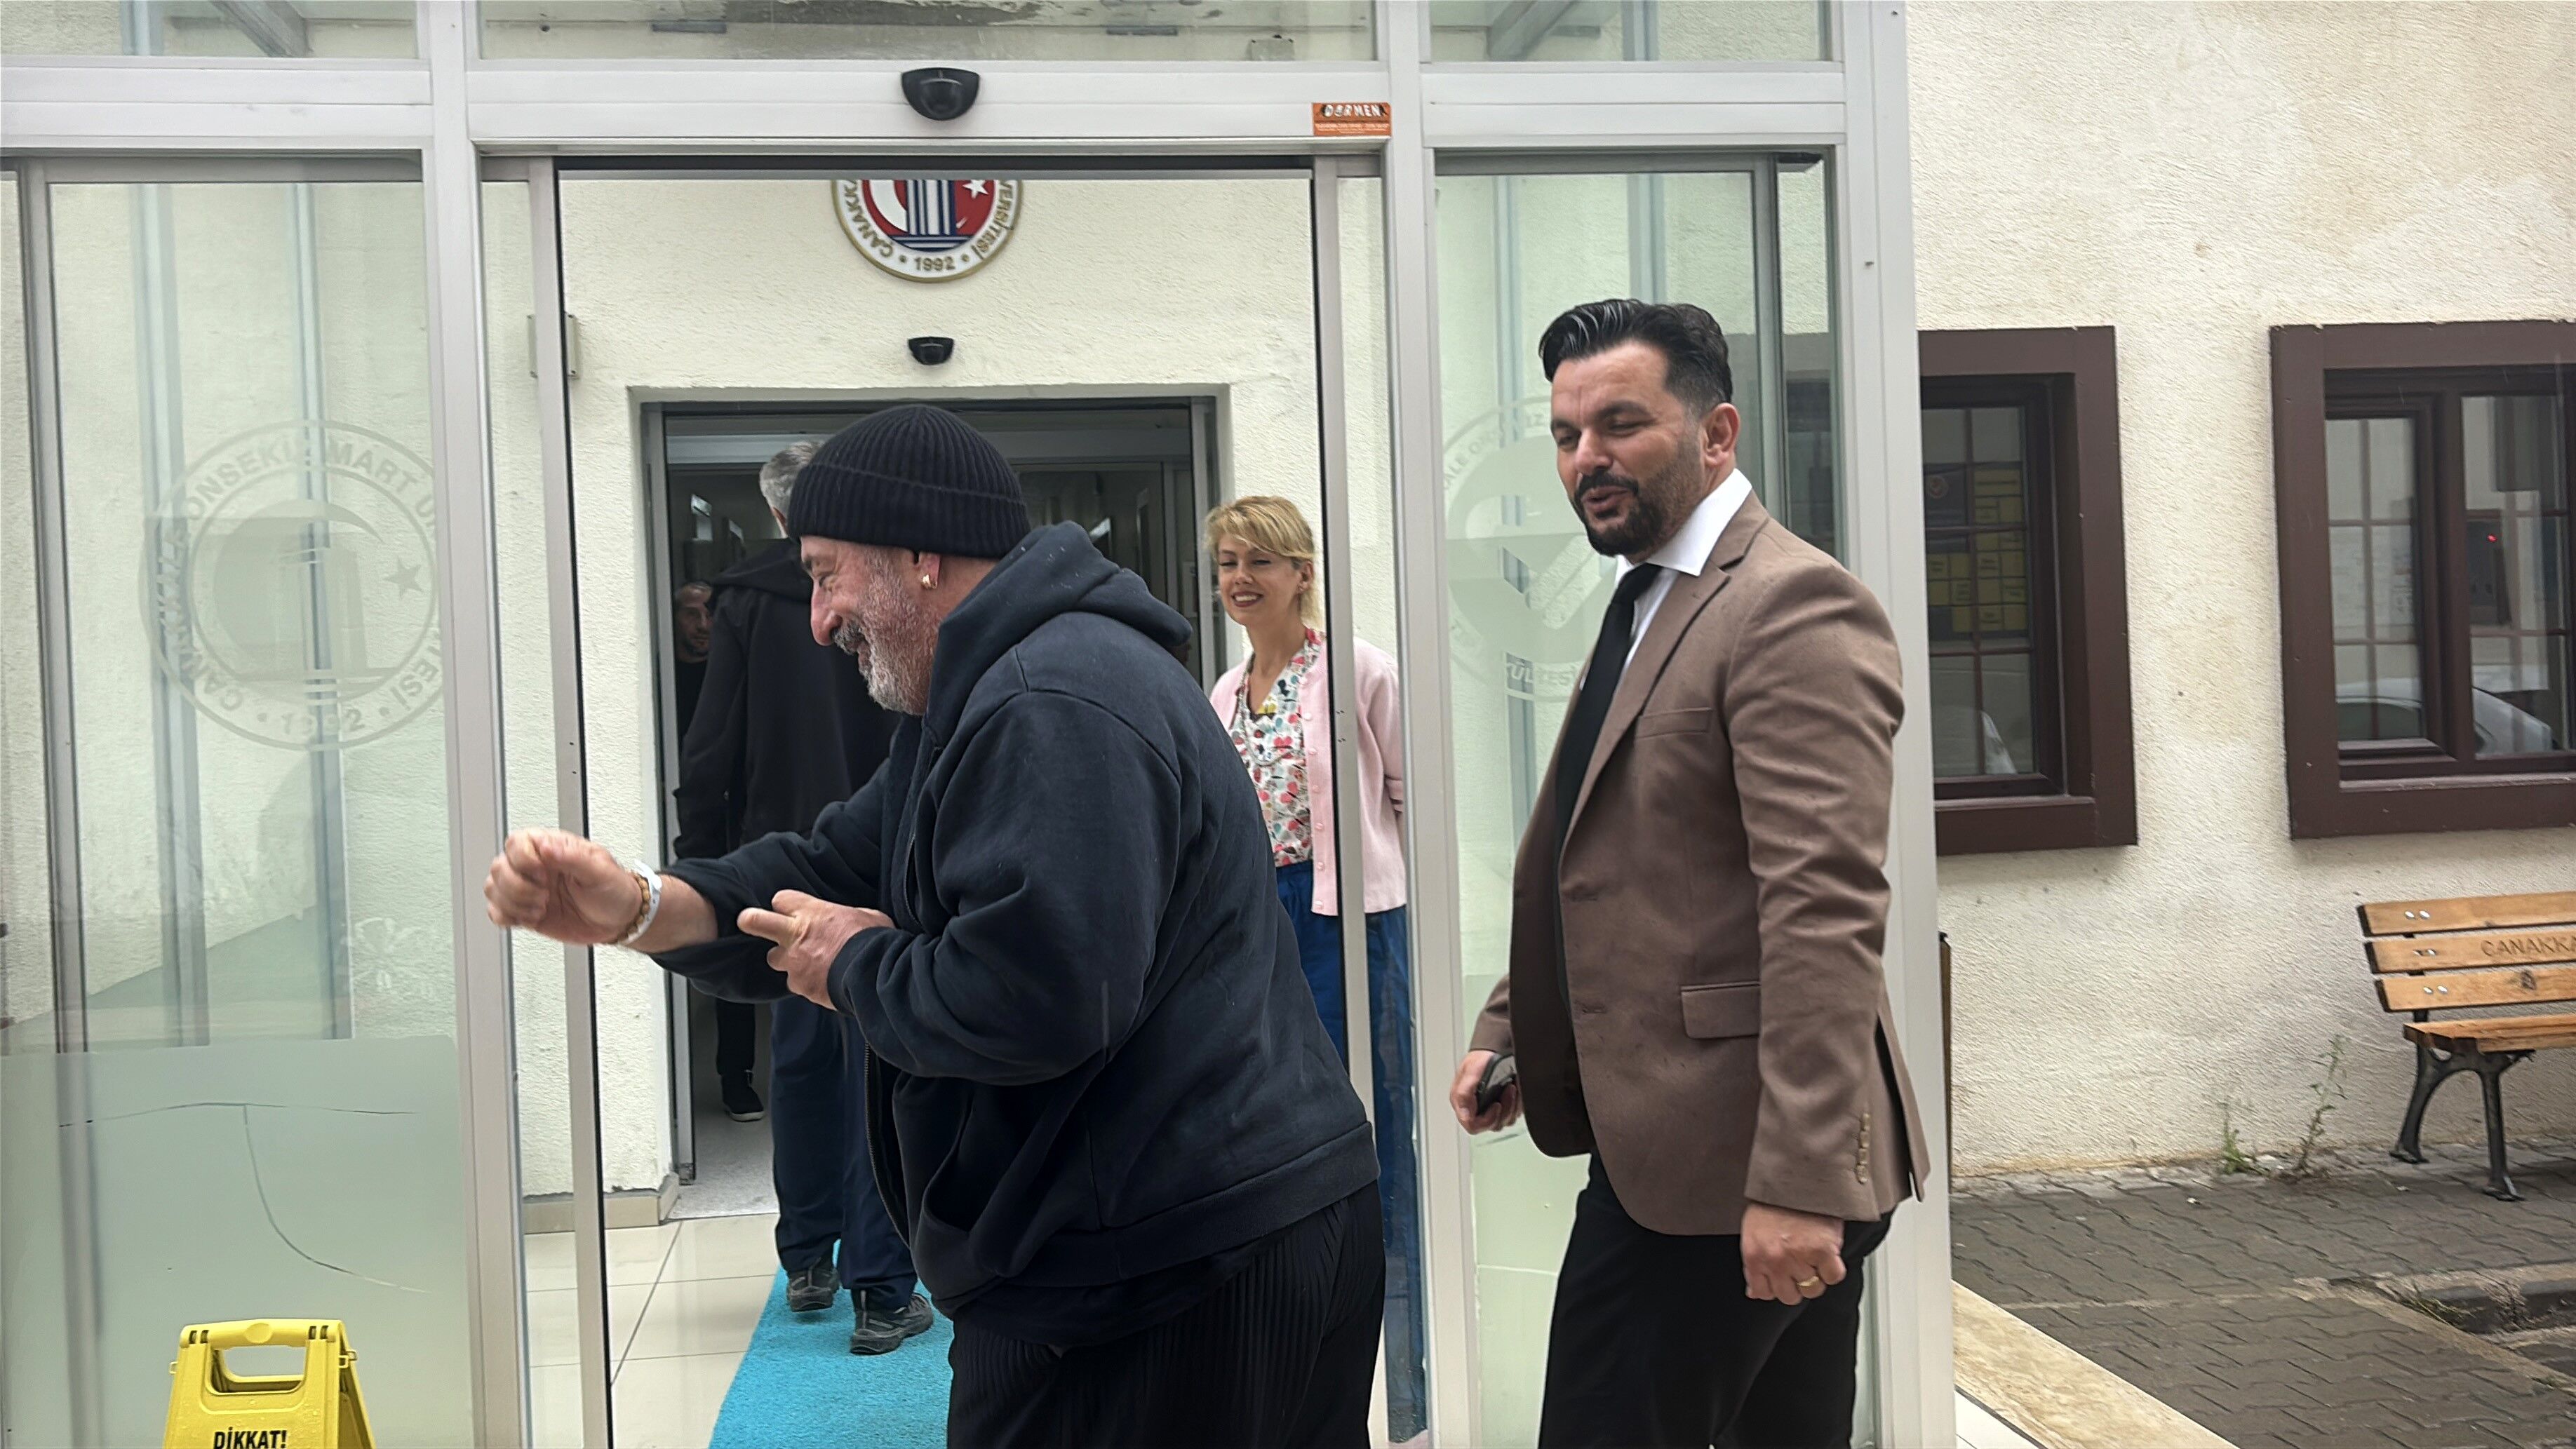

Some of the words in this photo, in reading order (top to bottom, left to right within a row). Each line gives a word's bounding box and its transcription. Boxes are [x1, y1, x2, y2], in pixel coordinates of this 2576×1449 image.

[913, 256, 956, 271] 1992
[328, 438, 418, 493] MART
[213, 1426, 288, 1449] DİKKAT!
